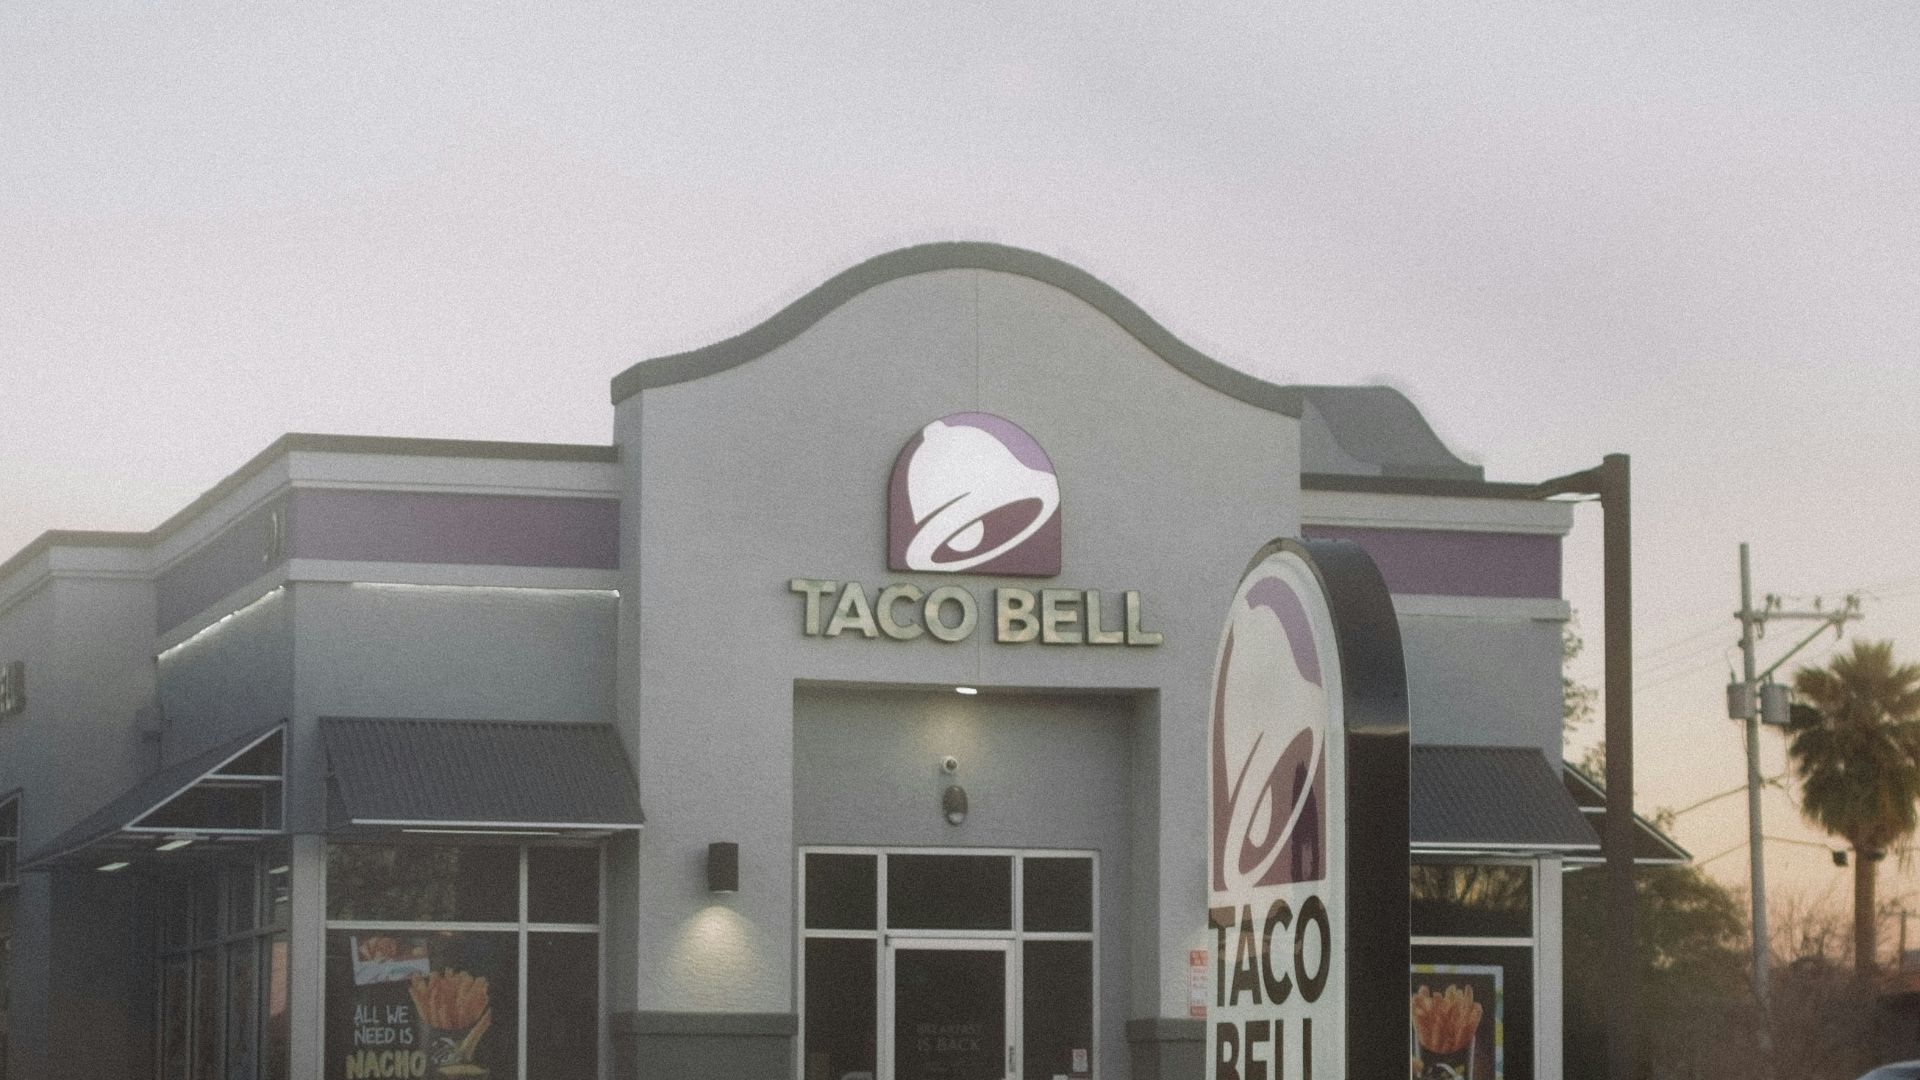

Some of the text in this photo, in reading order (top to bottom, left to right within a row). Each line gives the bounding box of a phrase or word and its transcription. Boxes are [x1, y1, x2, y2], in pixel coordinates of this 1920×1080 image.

[788, 578, 1164, 646] TACO BELL
[1208, 894, 1331, 1007] TACO
[354, 1004, 410, 1025] ALL WE
[354, 1026, 414, 1046] NEED IS
[345, 1049, 427, 1080] NACHO
